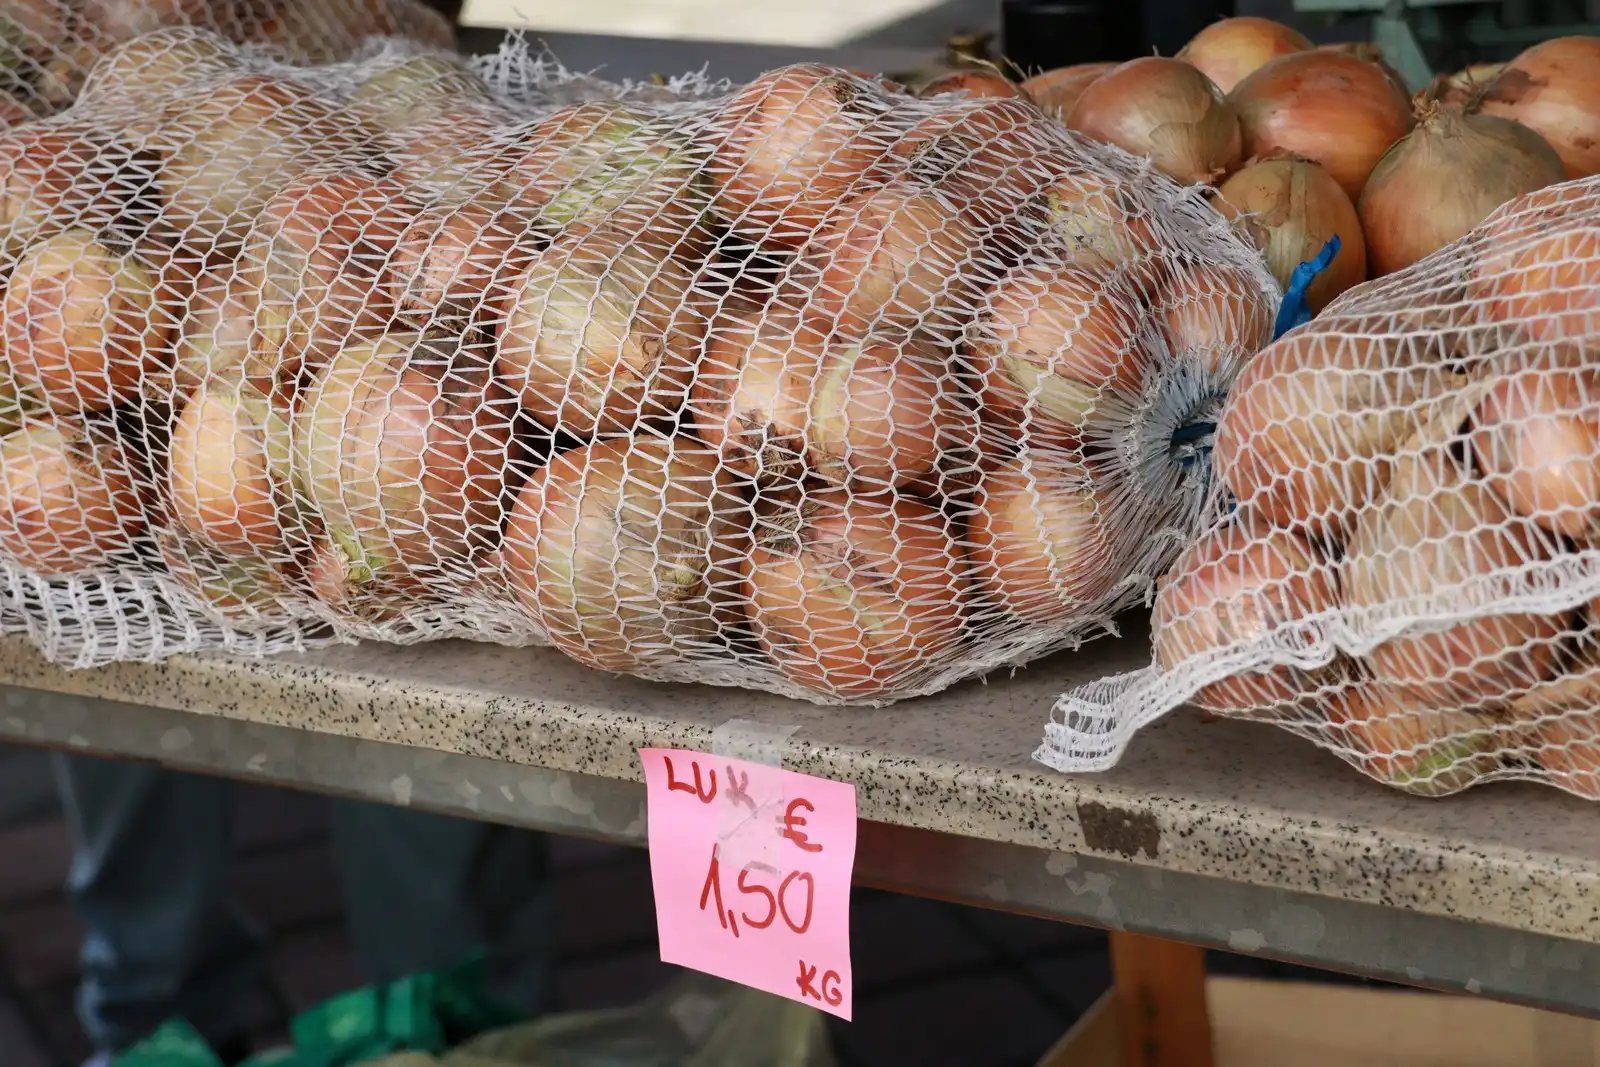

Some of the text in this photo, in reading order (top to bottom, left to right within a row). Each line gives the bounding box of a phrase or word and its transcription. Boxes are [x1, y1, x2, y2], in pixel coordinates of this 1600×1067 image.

[663, 756, 823, 852] LUK €
[700, 843, 814, 938] 1,50
[796, 960, 843, 1007] KG
